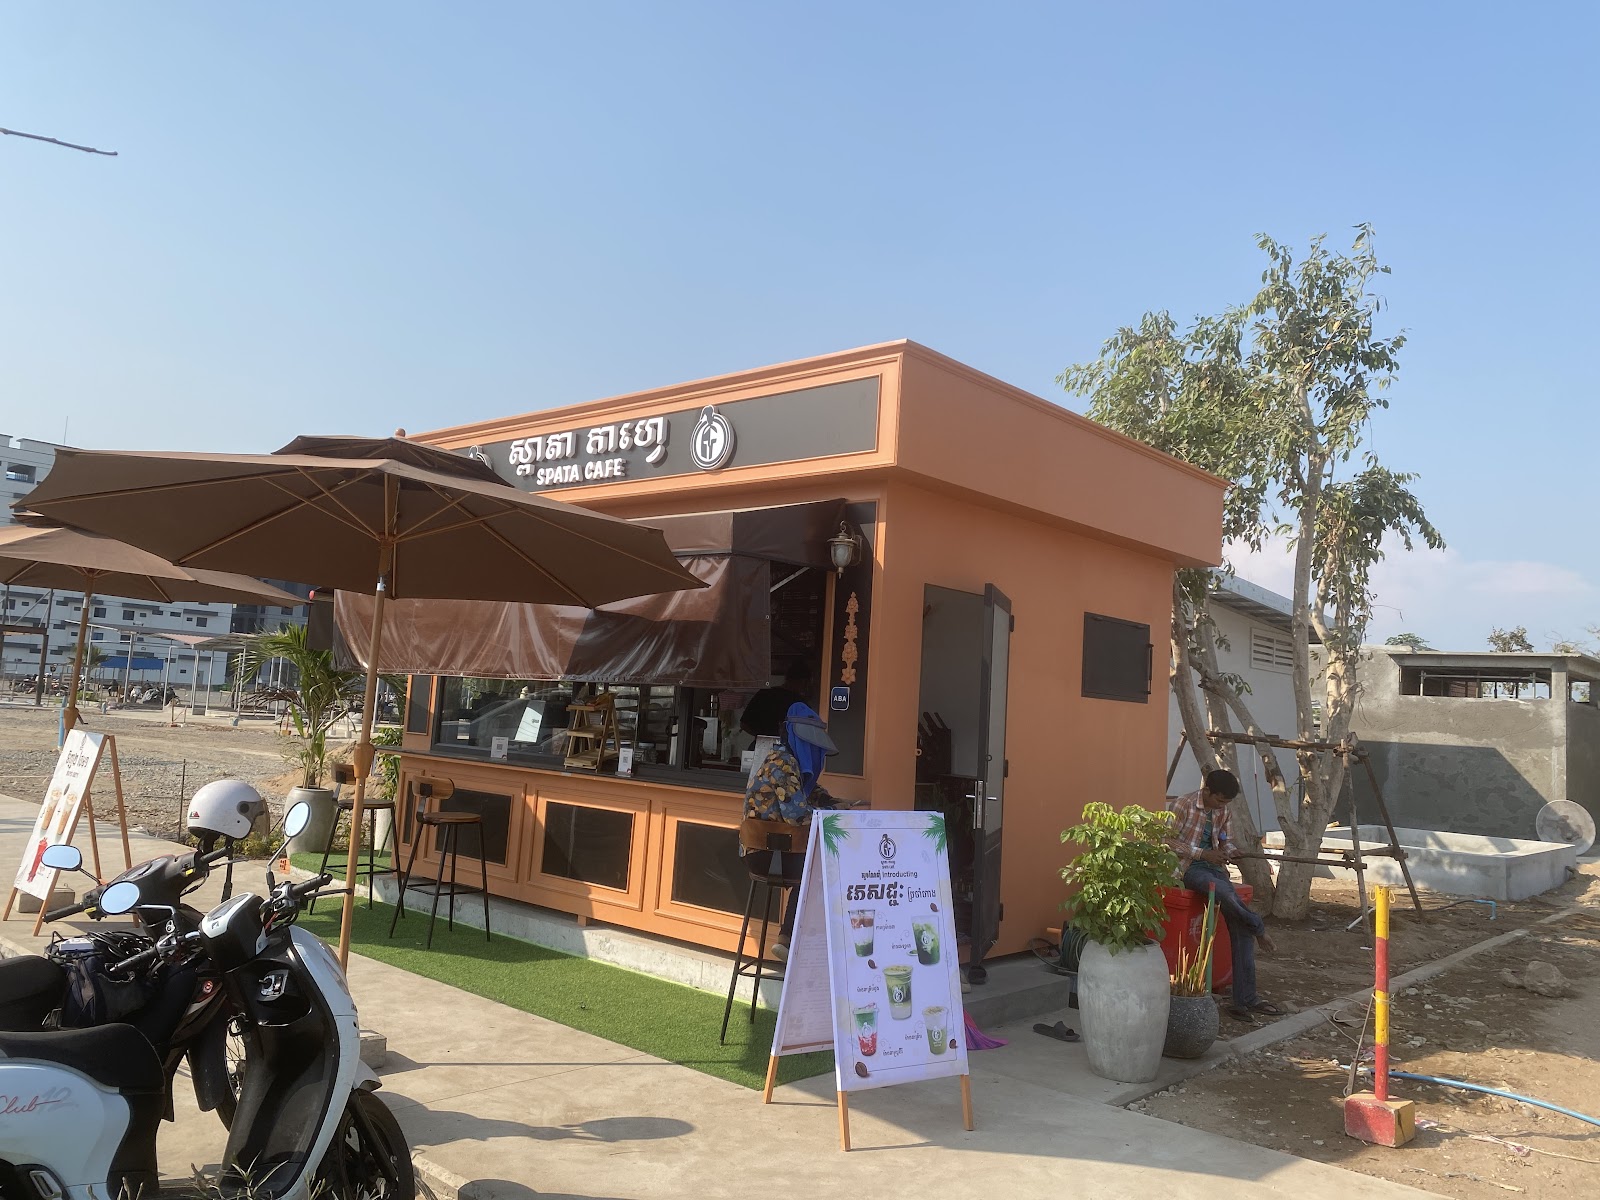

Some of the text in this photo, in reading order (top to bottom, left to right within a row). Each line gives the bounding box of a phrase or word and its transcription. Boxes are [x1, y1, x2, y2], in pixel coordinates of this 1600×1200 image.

[586, 416, 666, 464] កាហ្វេ
[536, 457, 624, 486] SPATA CAFE
